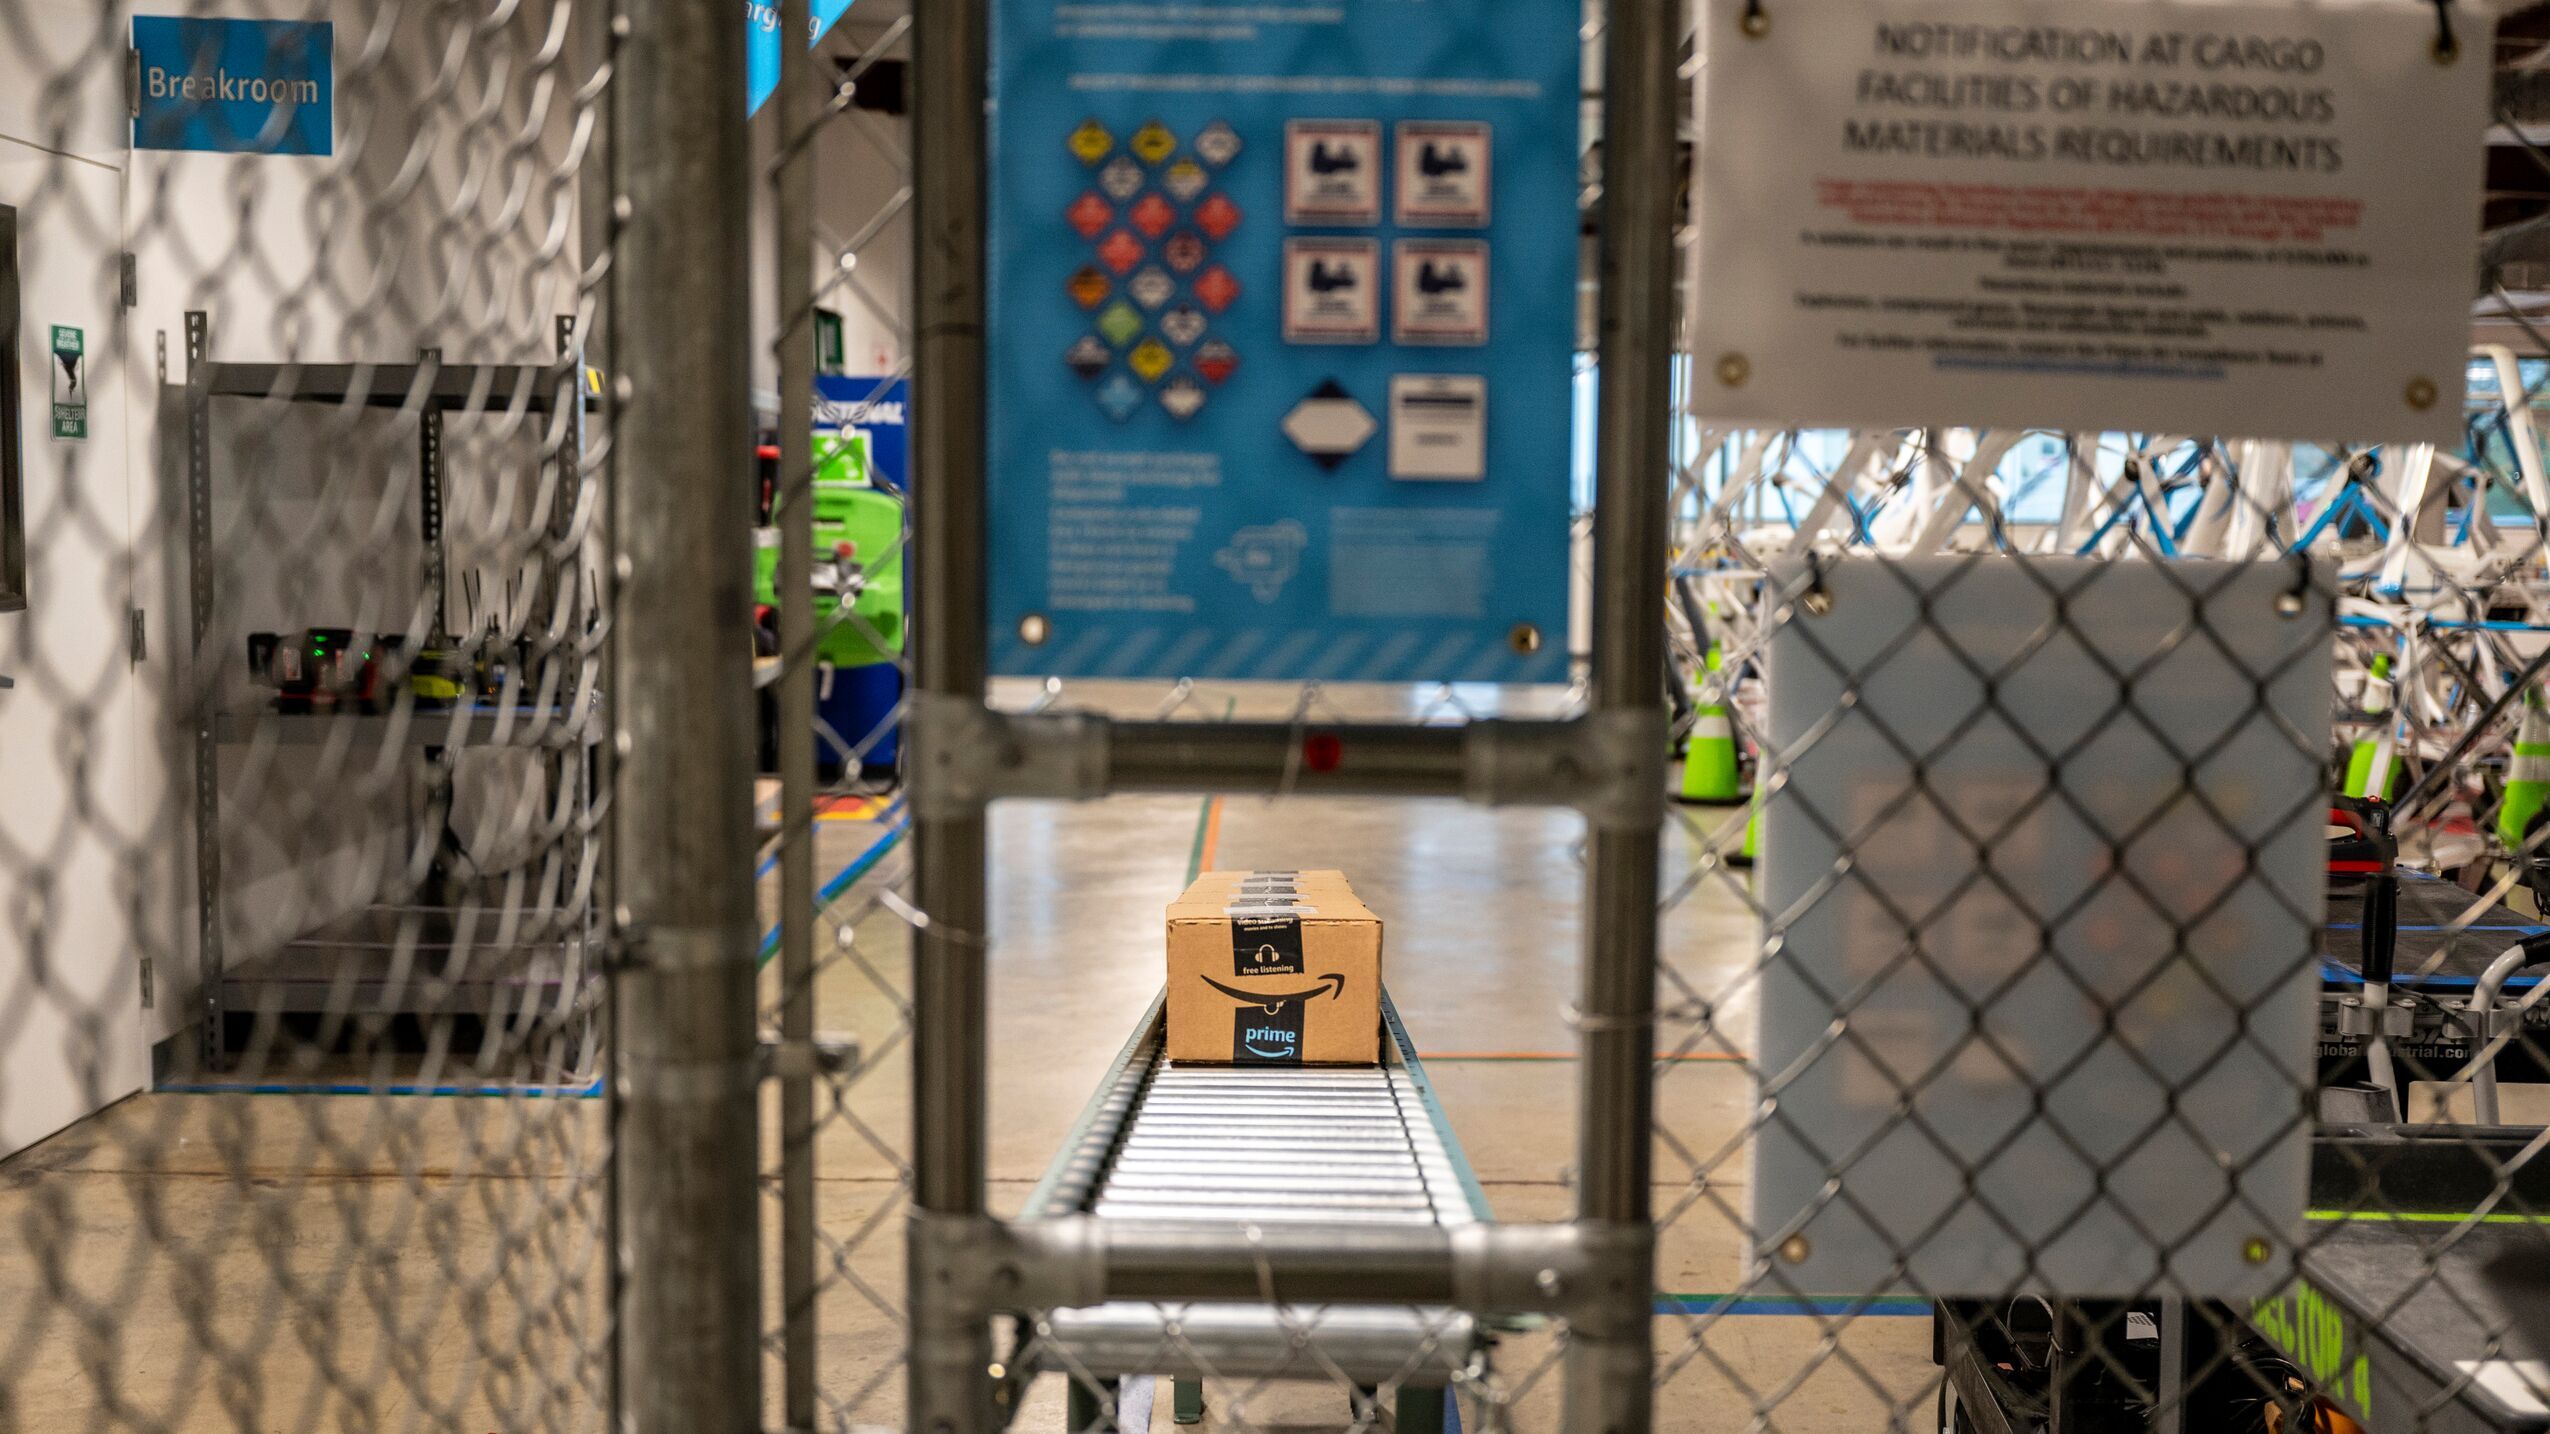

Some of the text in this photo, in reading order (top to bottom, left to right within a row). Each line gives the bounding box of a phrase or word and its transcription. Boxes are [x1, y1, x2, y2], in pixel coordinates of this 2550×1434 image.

[1874, 21, 2325, 75] NOTIFICATION AT CARGO
[149, 67, 318, 104] Breakroom
[1856, 68, 2337, 125] FACILITIES OF HAZARDOUS
[1842, 117, 2345, 174] MATERIALS REQUIREMENTS
[55, 405, 86, 421] SHELTER
[61, 420, 79, 433] AREA
[1243, 964, 1294, 974] free listening
[1245, 1026, 1296, 1043] prime
